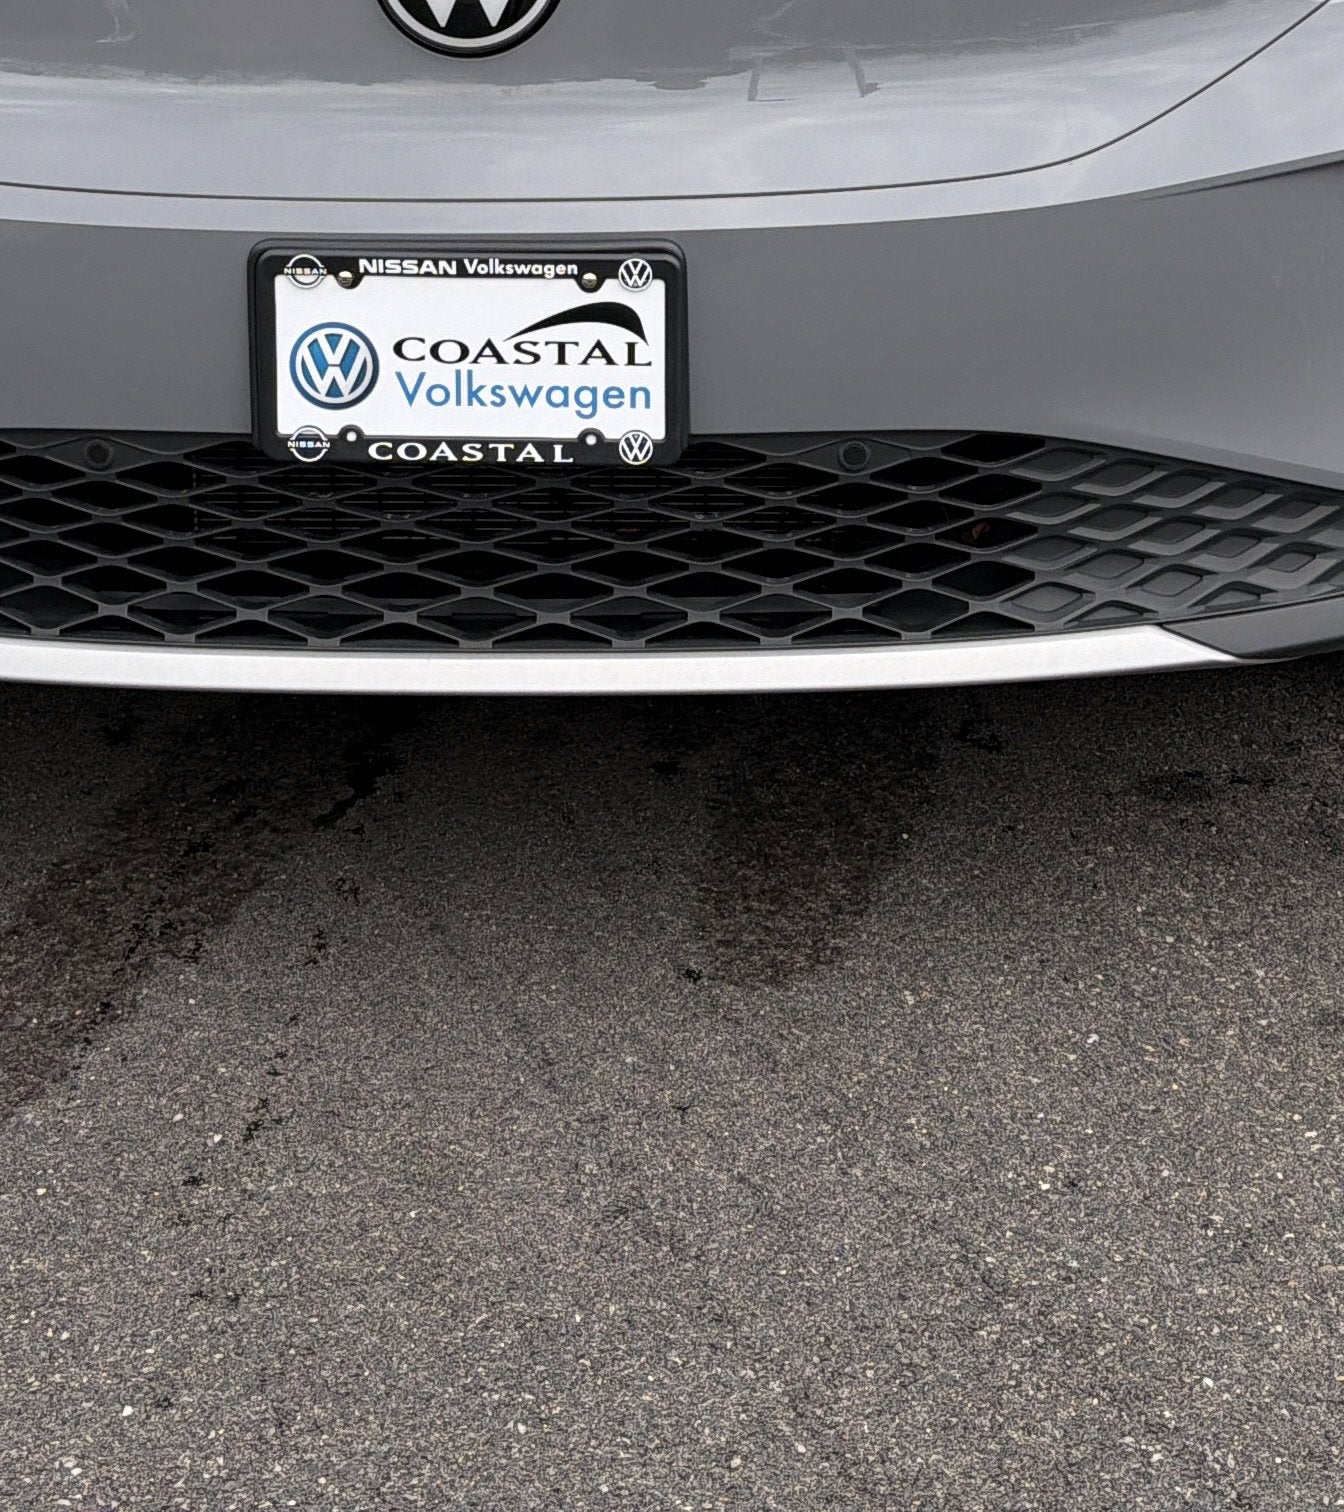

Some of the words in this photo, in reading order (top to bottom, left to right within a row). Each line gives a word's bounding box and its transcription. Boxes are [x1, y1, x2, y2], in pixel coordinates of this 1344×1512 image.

[284, 267, 327, 276] NISSAN
[359, 258, 457, 275] NISSAN
[463, 258, 578, 279] Volkswagen
[392, 336, 653, 367] COASTAL
[394, 369, 652, 419] Volkswagen
[287, 440, 331, 449] NISSAN
[367, 440, 574, 464] COASTAL
